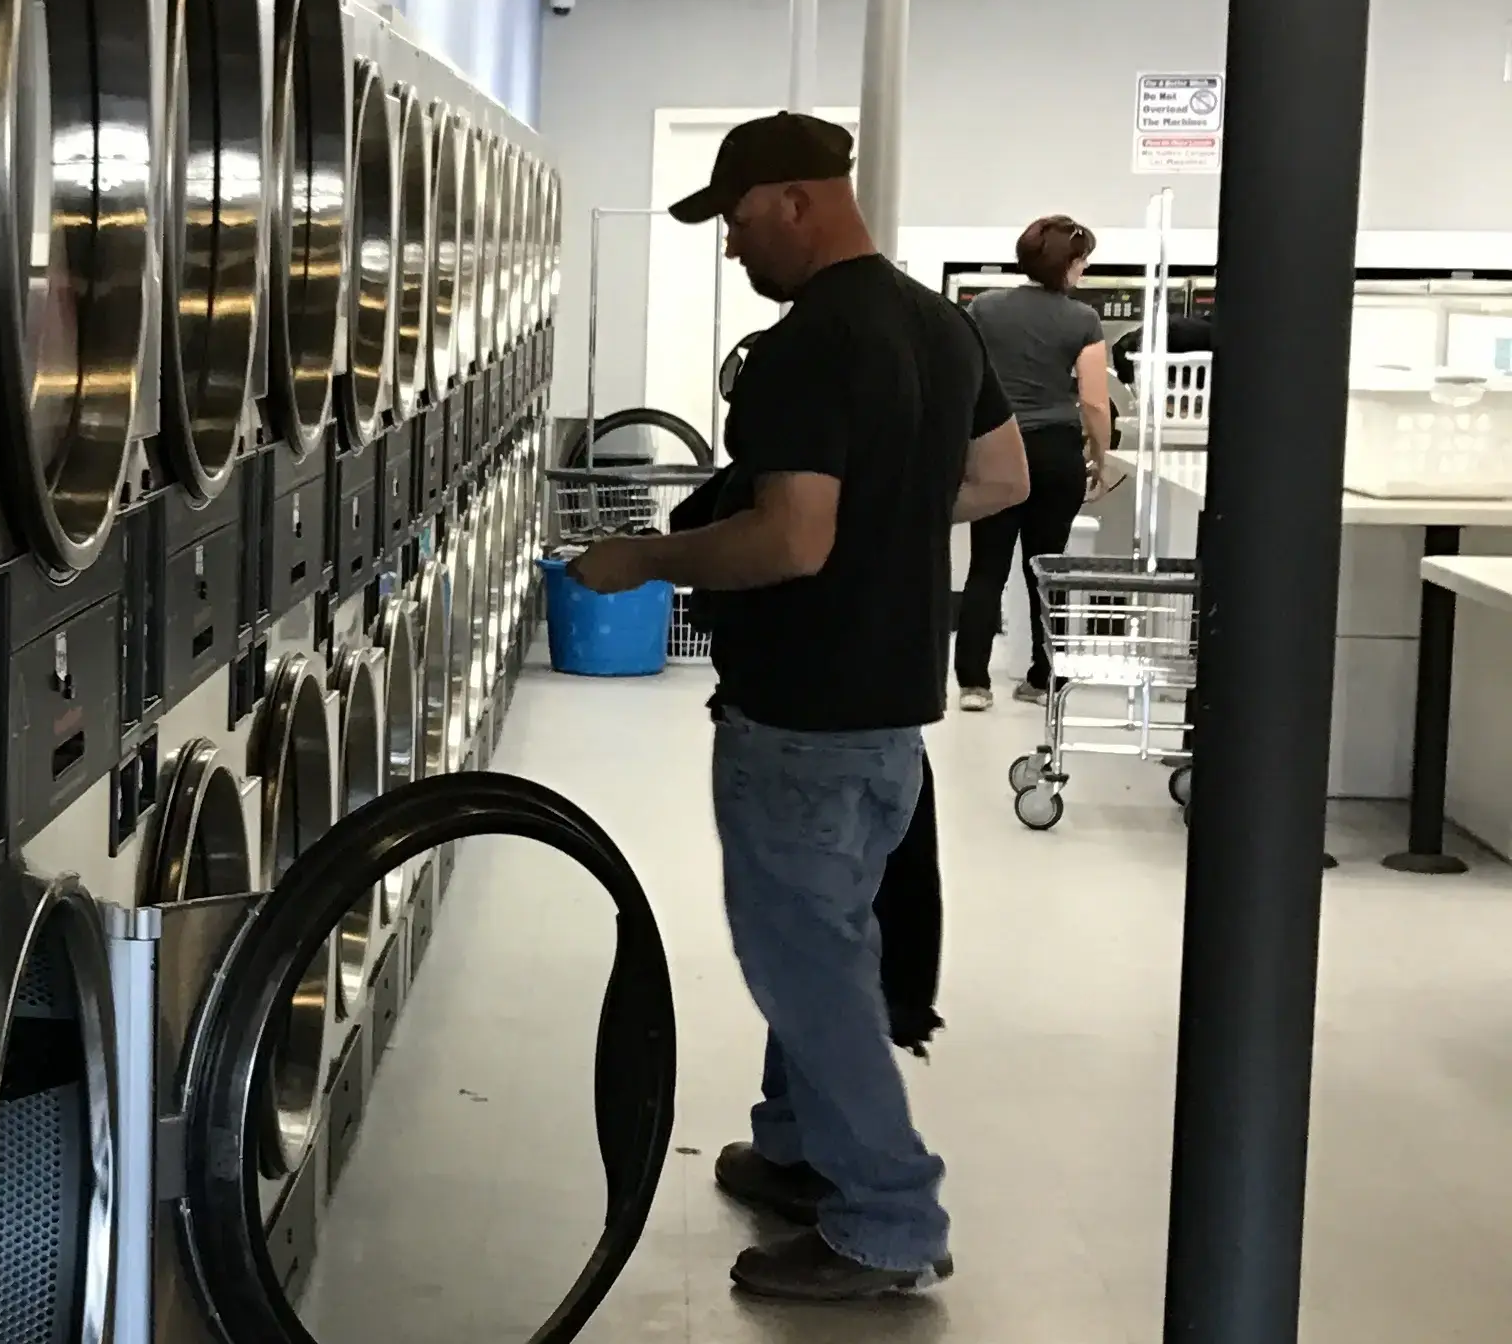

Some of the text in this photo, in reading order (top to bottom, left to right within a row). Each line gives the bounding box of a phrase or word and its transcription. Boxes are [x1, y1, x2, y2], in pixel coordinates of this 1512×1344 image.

[1143, 92, 1177, 101] Do Not
[1143, 105, 1188, 114] Overload
[1143, 118, 1207, 126] The Machines
